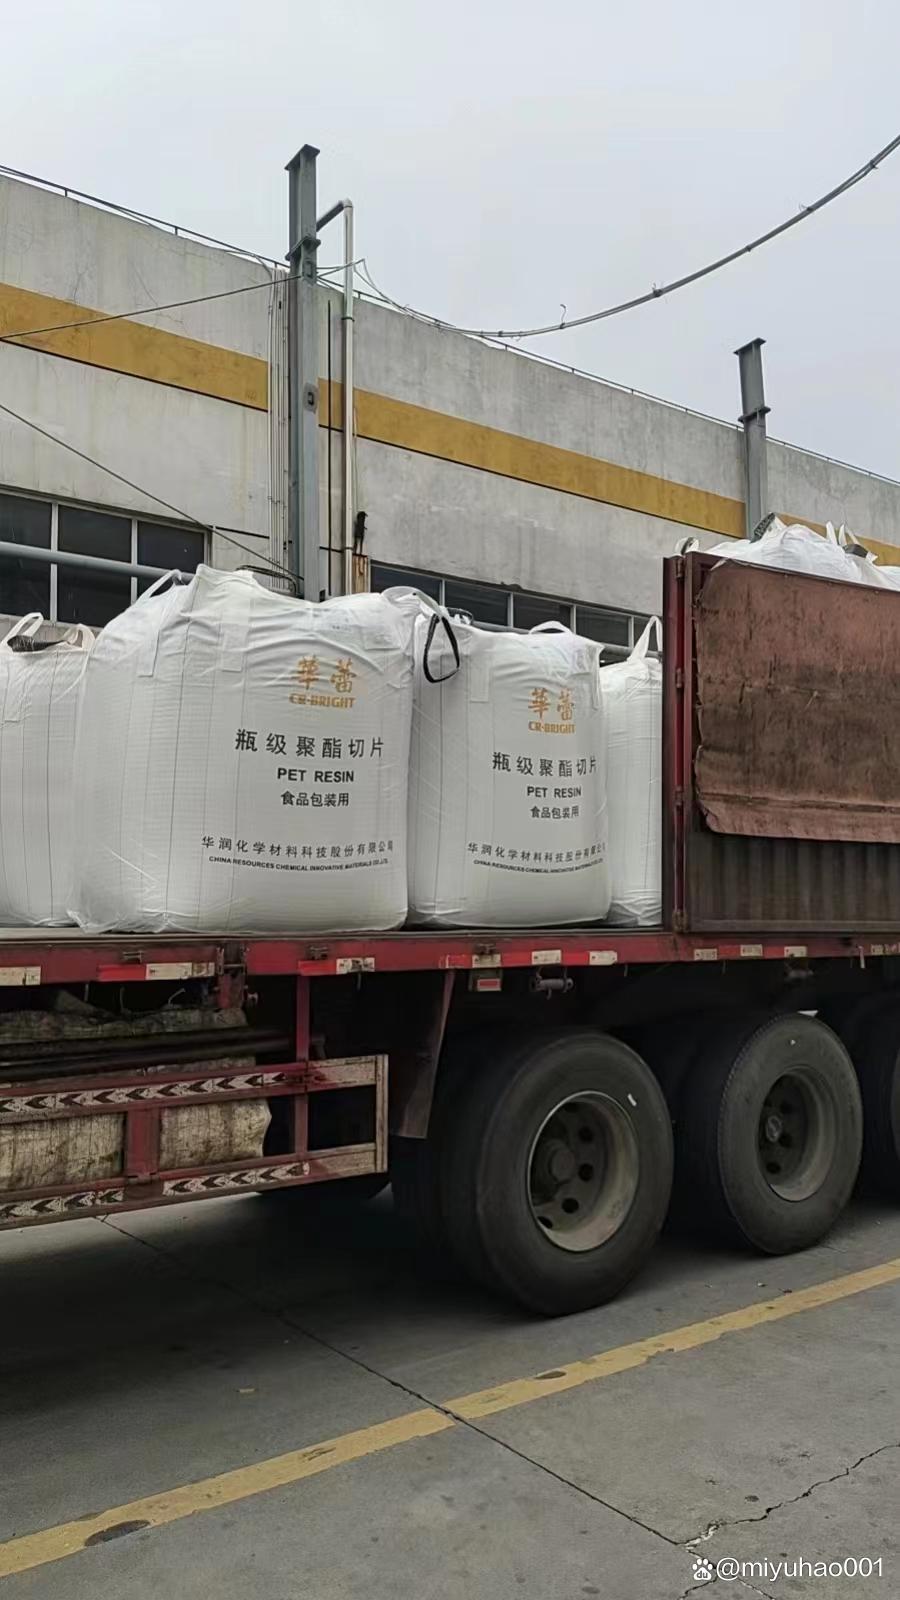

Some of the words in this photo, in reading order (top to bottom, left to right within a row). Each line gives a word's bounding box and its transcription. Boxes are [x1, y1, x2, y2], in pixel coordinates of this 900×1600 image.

[235, 728, 384, 759] 瓶级聚酯切片
[492, 751, 597, 777] 瓶级聚酯切片
[277, 767, 307, 782] PET
[314, 770, 355, 783] RESIN
[281, 790, 350, 807] 食品包装用
[527, 786, 548, 798] PET
[554, 786, 582, 799] RESIN
[530, 805, 580, 819] 食品包装用
[208, 856, 231, 864] CHINA
[233, 858, 275, 869] RESOURCES
[276, 863, 309, 871] CHEMICAL
